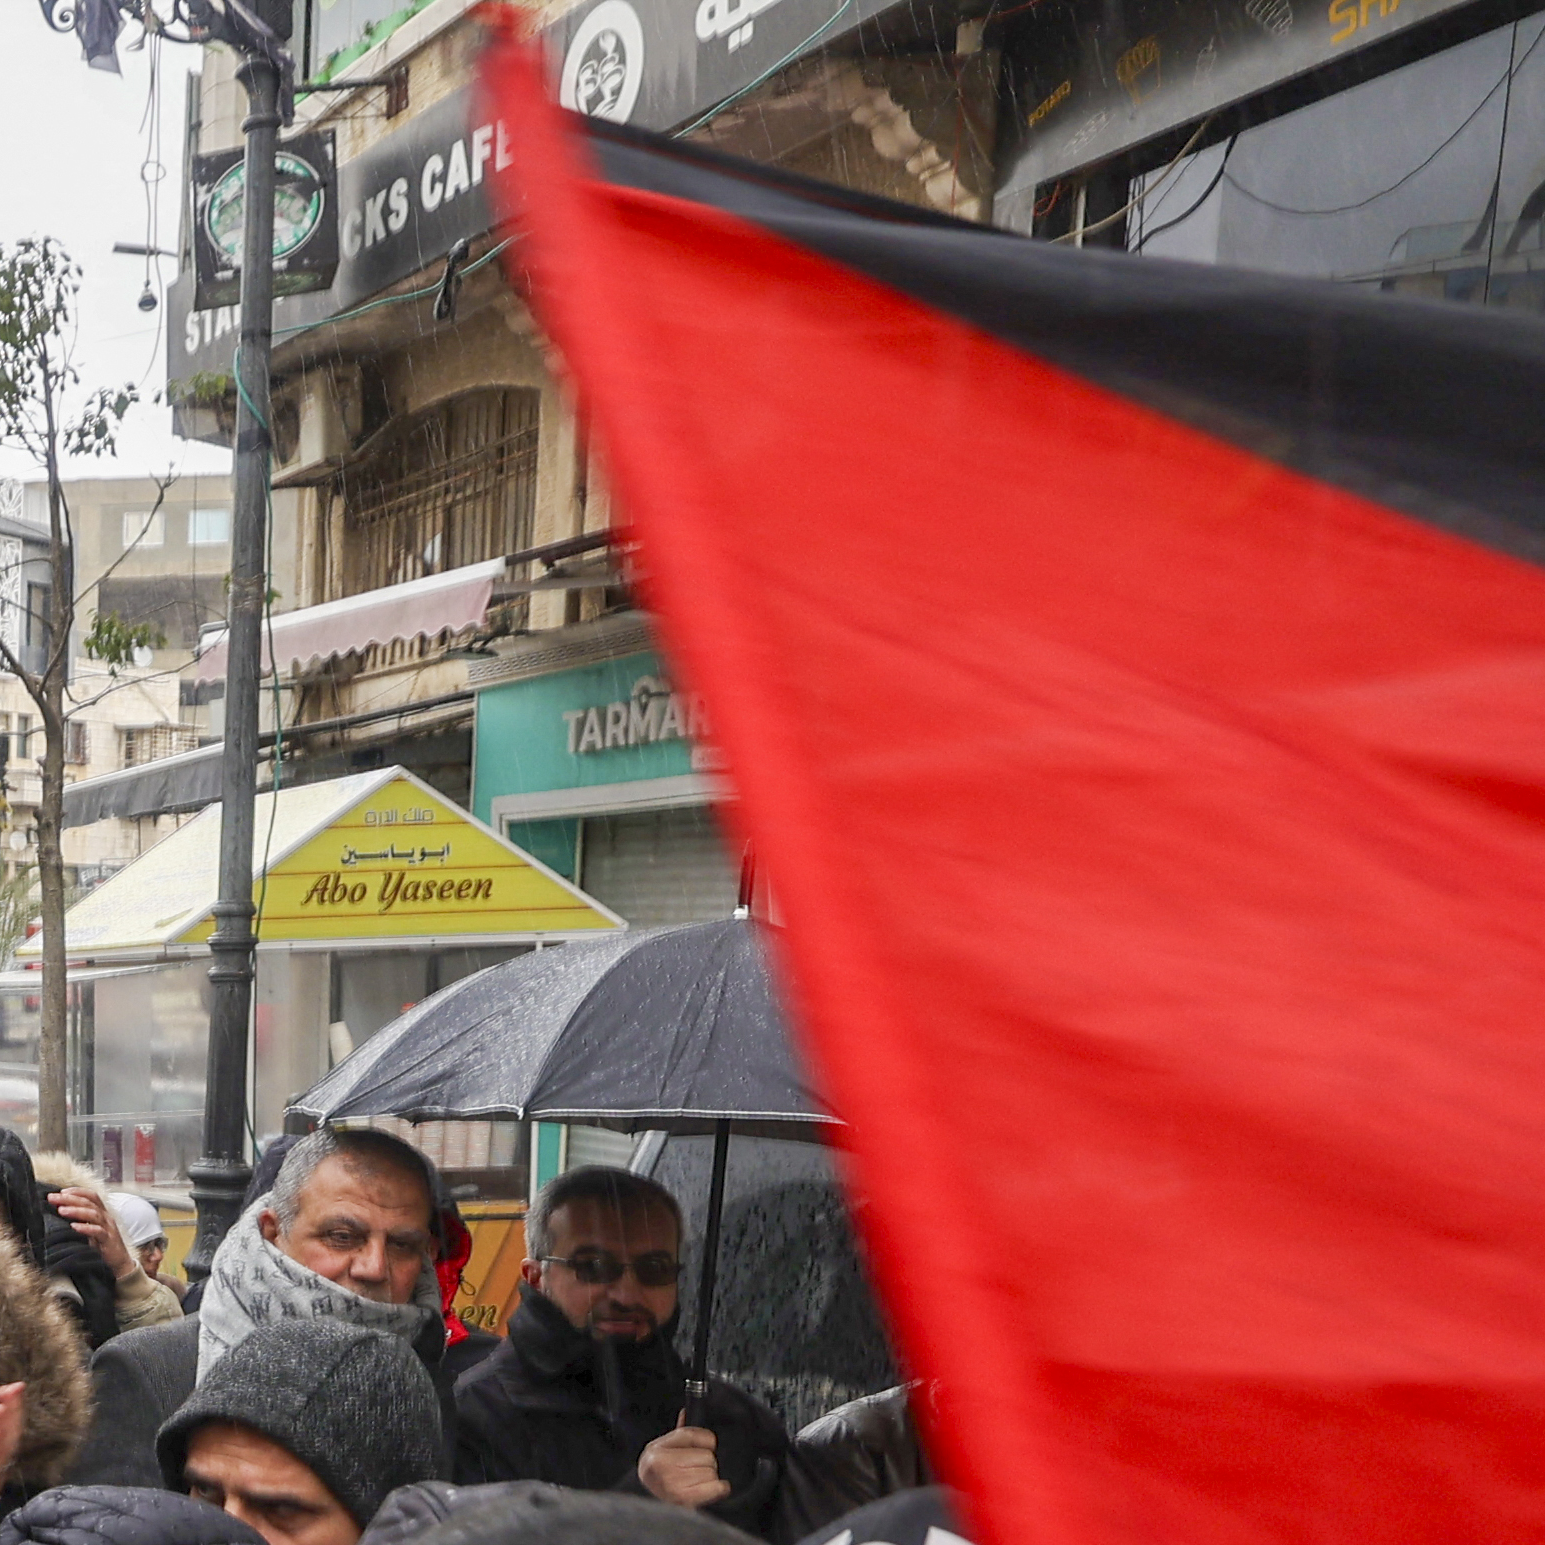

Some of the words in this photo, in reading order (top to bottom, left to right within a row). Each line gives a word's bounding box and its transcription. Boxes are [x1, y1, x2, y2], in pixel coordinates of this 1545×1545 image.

[185, 304, 242, 356] STA
[342, 177, 409, 260] CKS
[340, 842, 416, 865] ياسين
[300, 871, 368, 906] Abo
[376, 871, 494, 914] Yaseen
